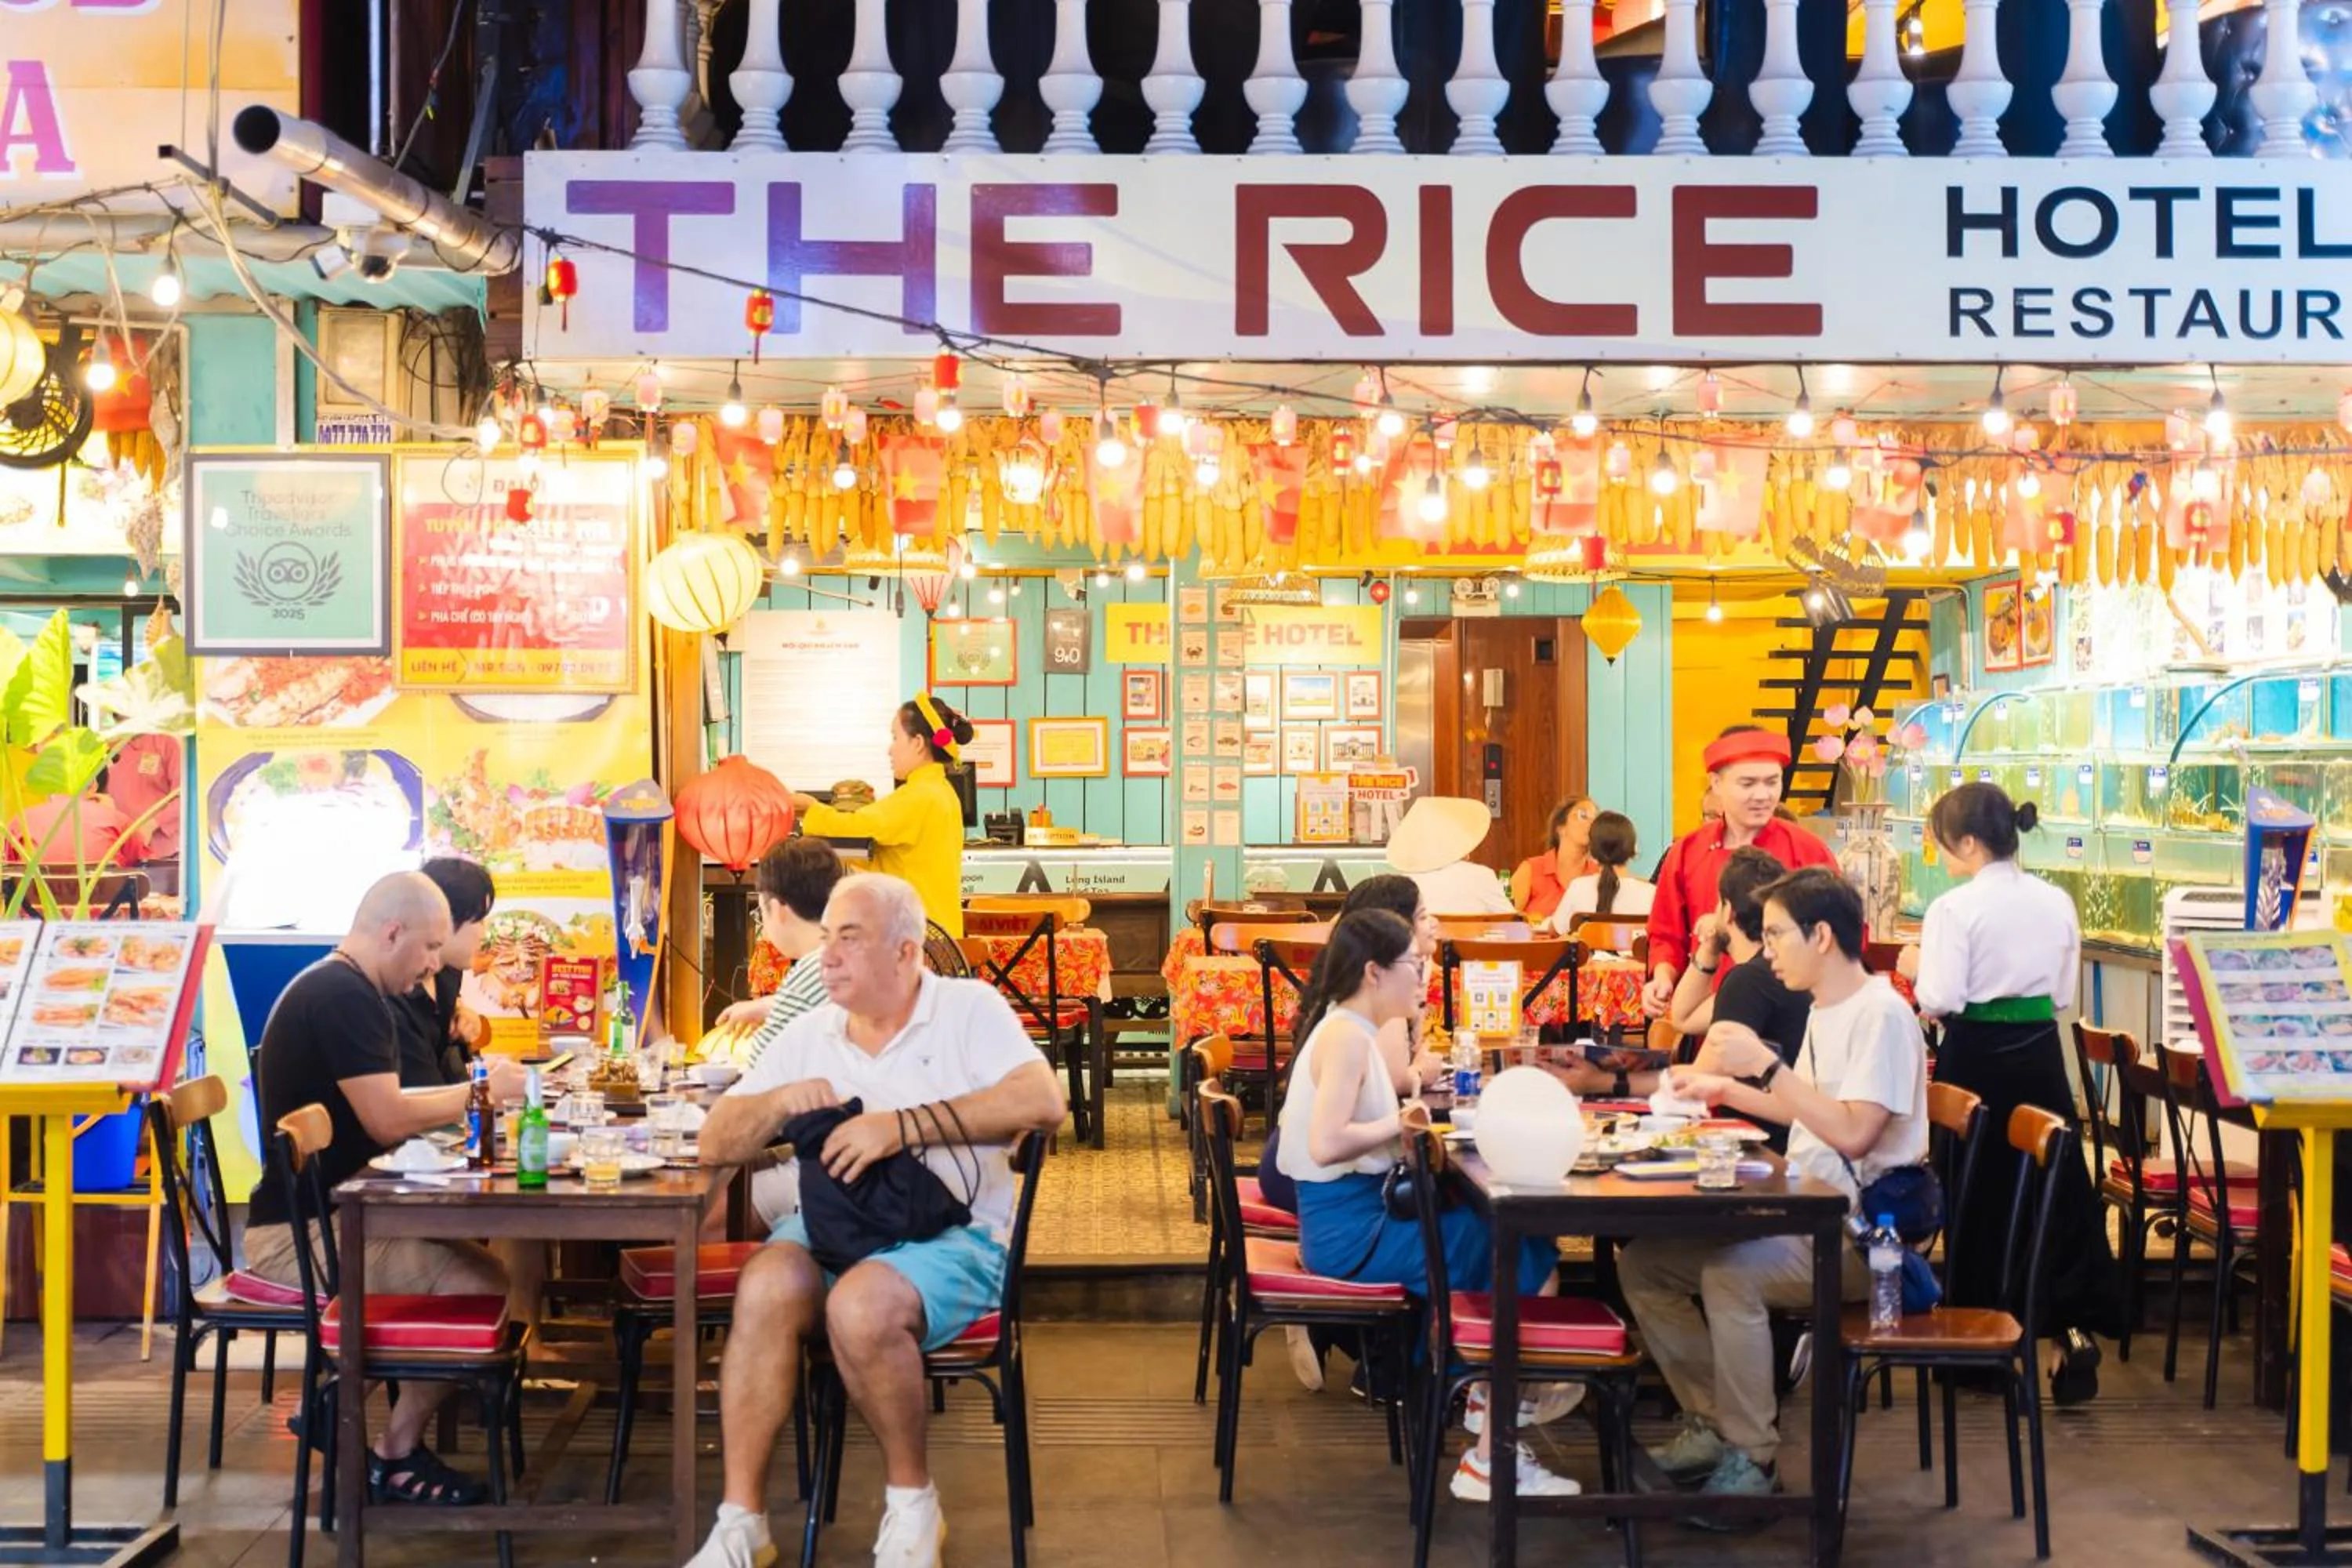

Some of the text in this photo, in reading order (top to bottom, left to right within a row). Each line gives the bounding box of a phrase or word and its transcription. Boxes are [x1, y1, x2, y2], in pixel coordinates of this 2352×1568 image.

[1946, 185, 2352, 260] HOTEL
[565, 180, 1823, 336] THE RICE
[1948, 287, 2344, 339] RESTAUR
[240, 489, 337, 506] Tripadvisor
[224, 521, 353, 537] Choice Awards
[272, 609, 305, 620] 2025
[1125, 622, 1171, 645] TH
[1265, 622, 1363, 646] HOTEL
[1375, 775, 1406, 787] RICE
[1357, 790, 1396, 800] HOTEL
[1094, 874, 1125, 884] Island
